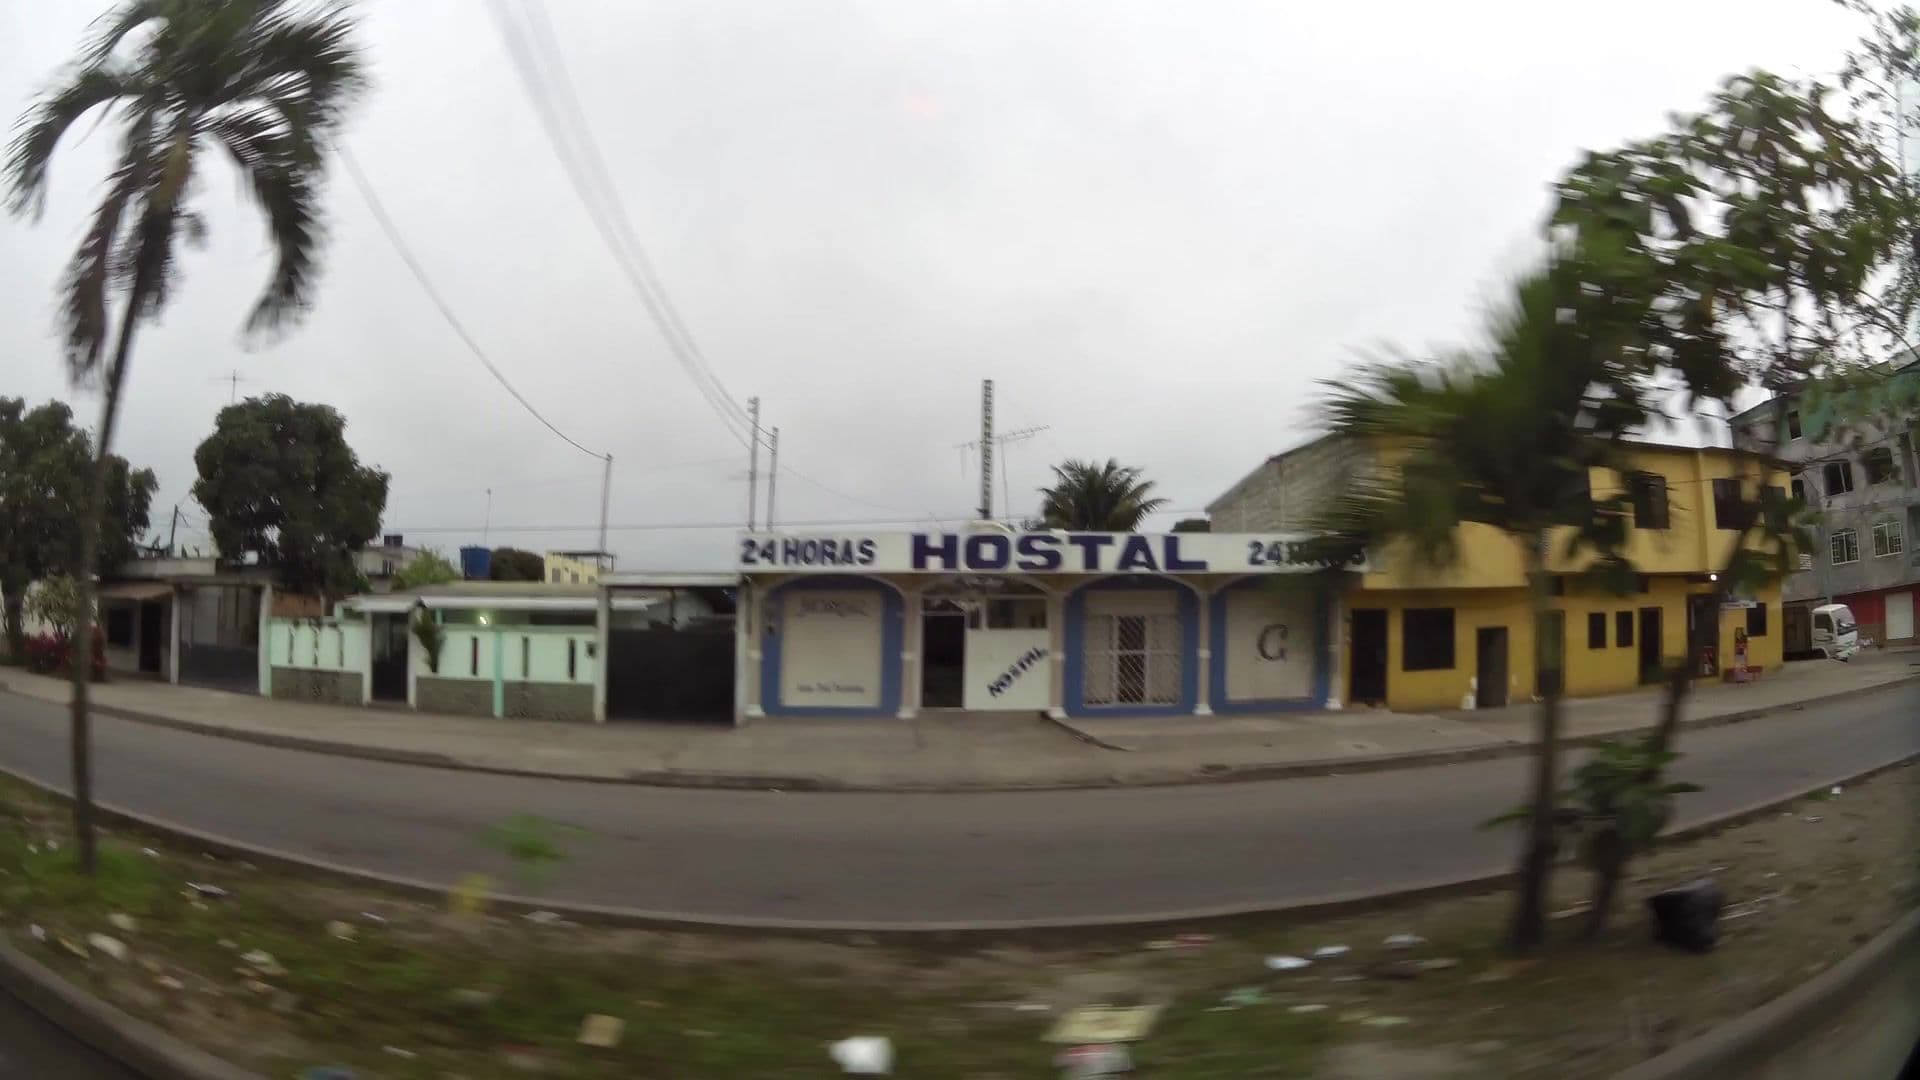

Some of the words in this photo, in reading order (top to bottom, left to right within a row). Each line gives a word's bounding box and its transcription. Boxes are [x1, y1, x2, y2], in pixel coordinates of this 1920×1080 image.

[741, 538, 776, 565] 24
[783, 538, 877, 566] HORAS
[912, 534, 1208, 571] HOSTAL
[1248, 540, 1282, 565] 24
